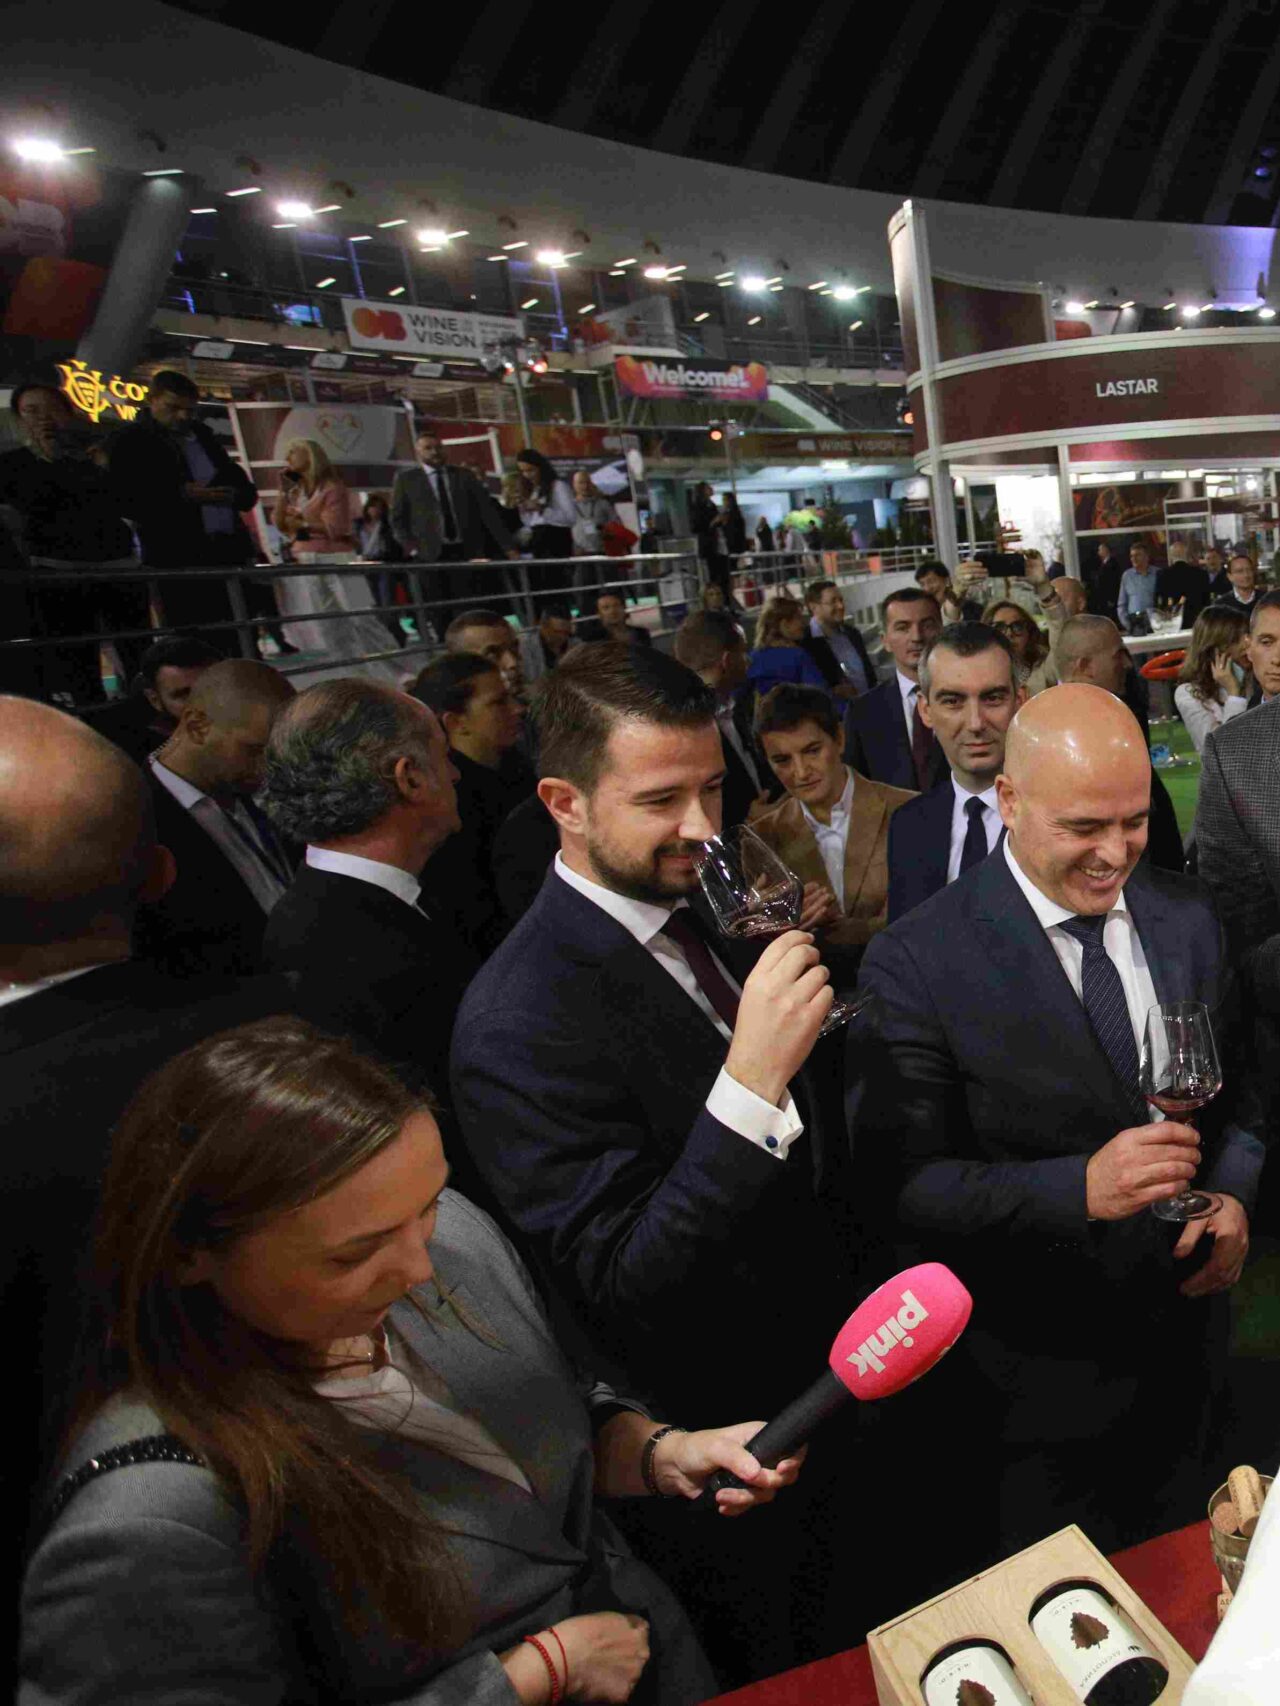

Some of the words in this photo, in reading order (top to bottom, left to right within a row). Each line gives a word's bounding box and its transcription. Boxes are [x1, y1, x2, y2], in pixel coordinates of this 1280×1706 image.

[408, 312, 458, 332] WINE
[413, 329, 477, 348] VISION
[643, 363, 749, 387] Welcome!
[108, 375, 149, 402] ČO
[1096, 378, 1159, 397] LASTAR
[846, 1289, 930, 1378] pink
